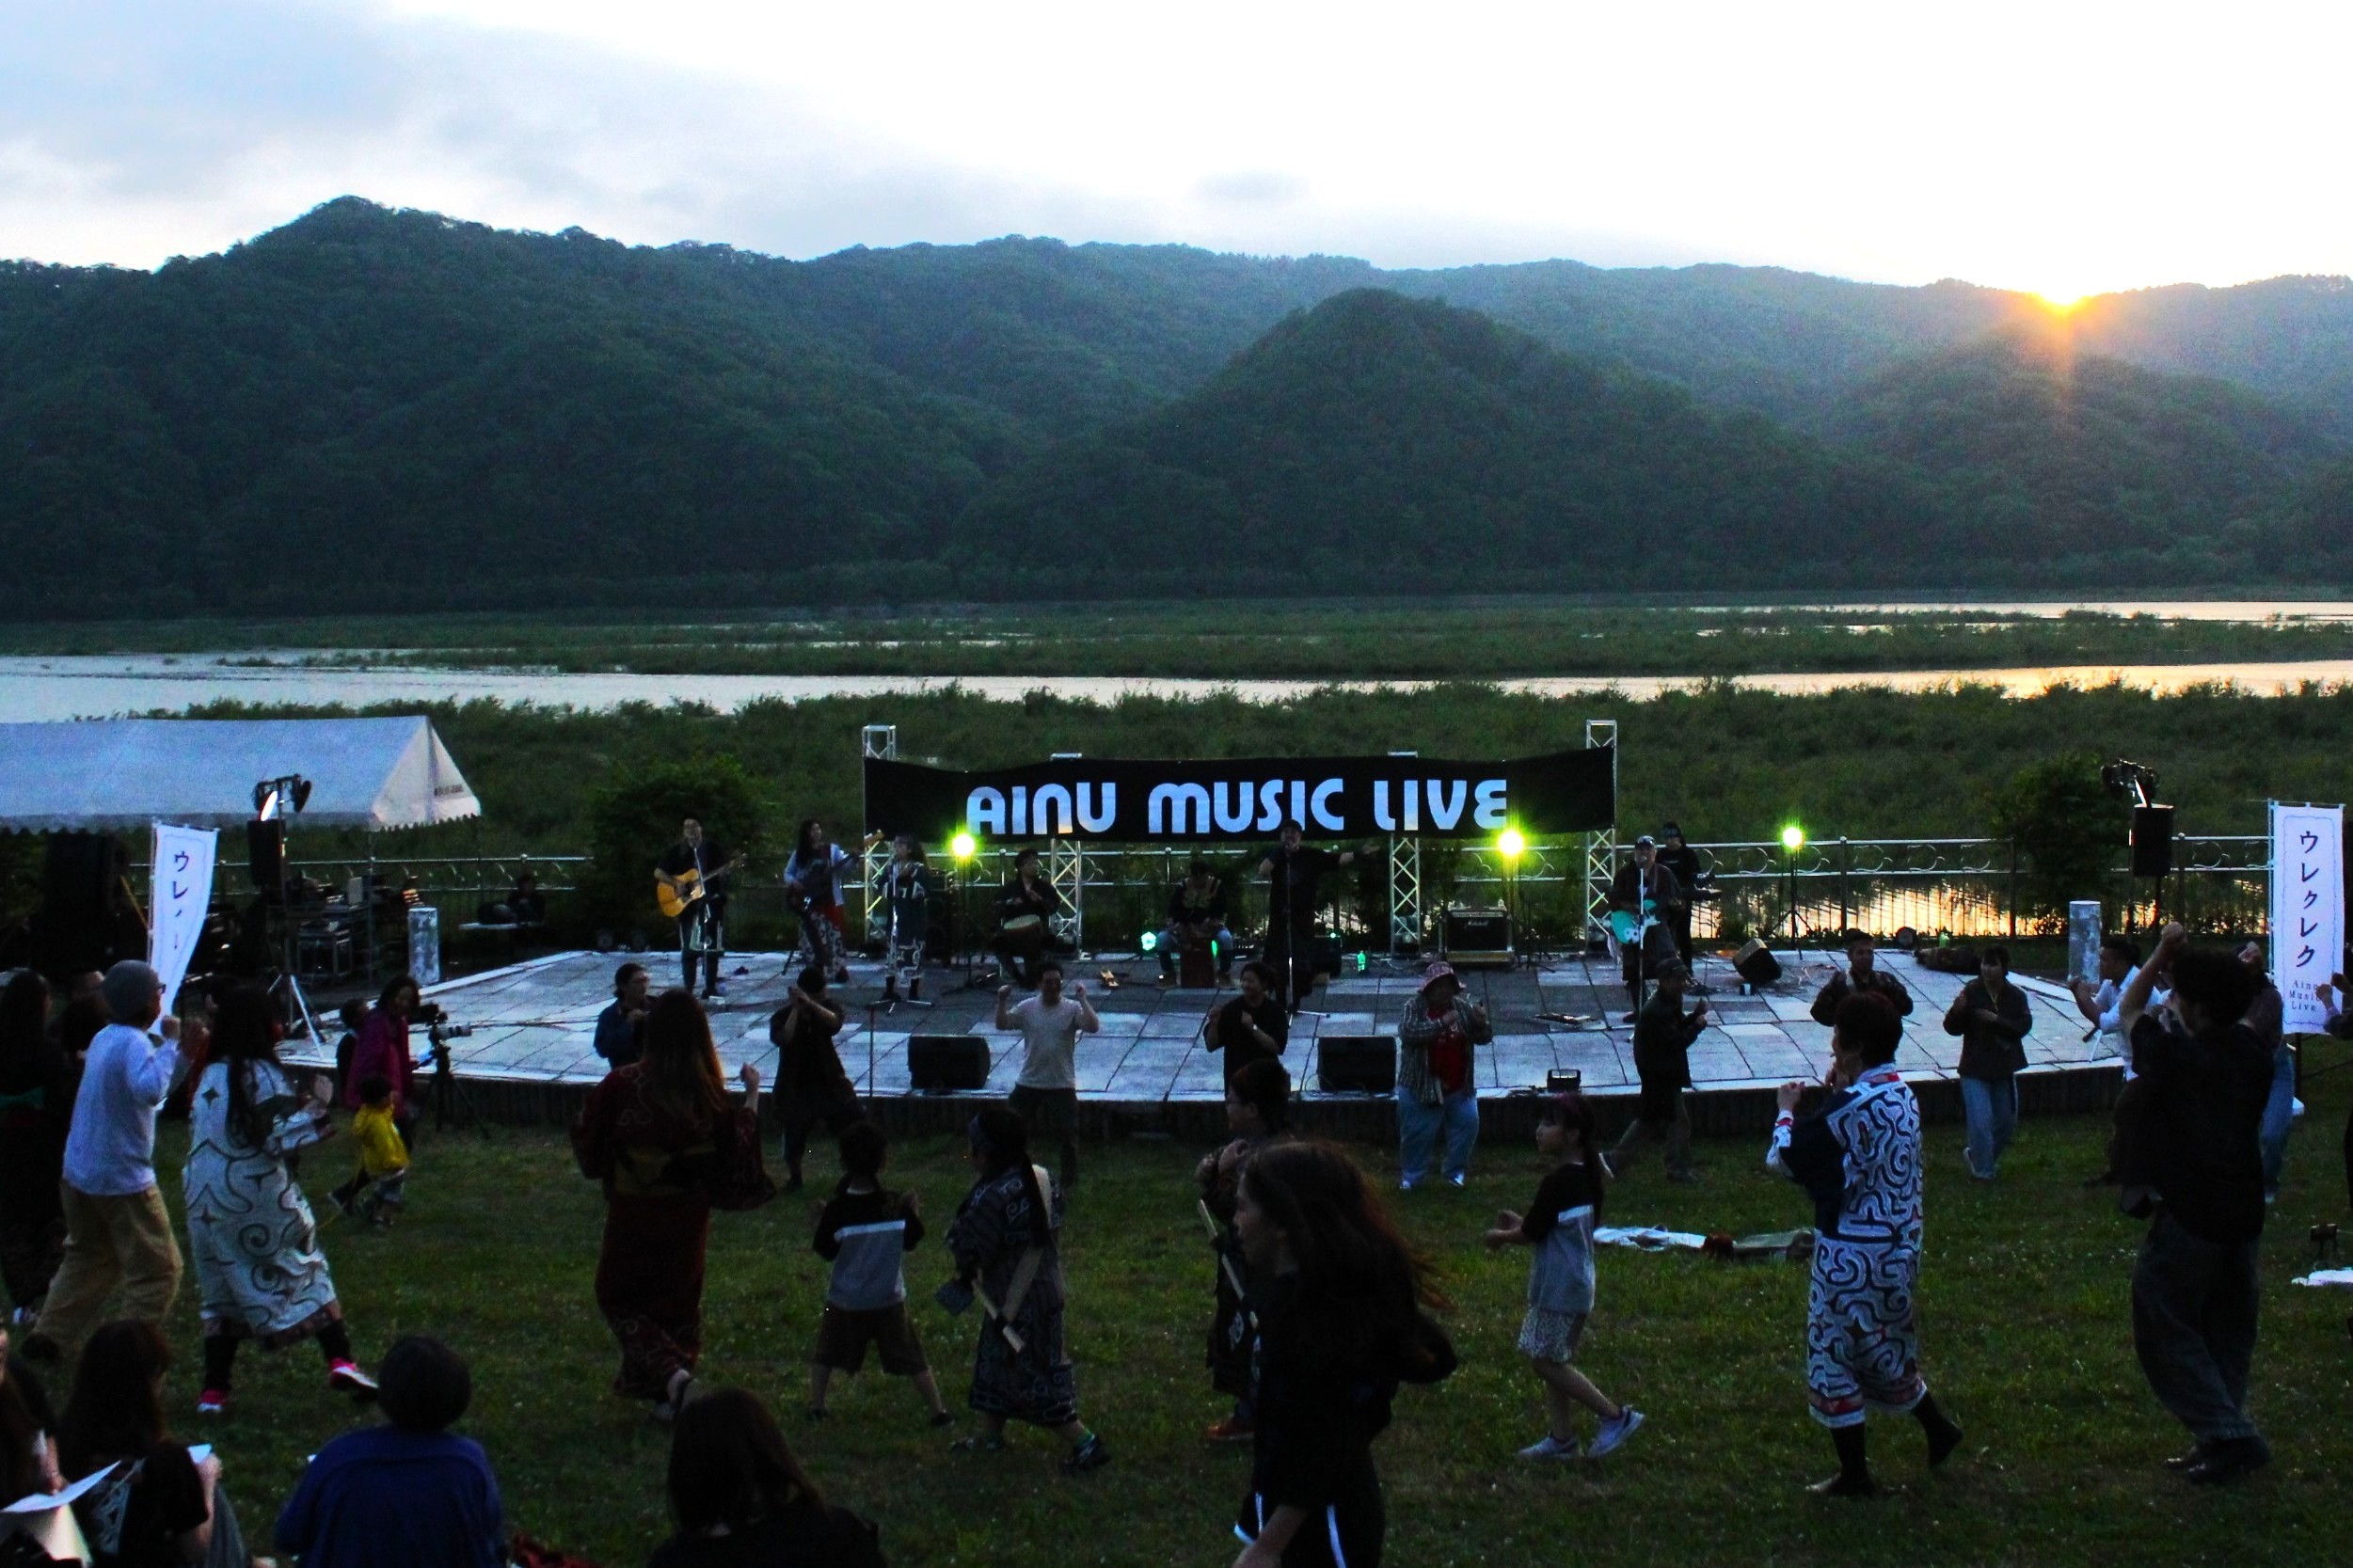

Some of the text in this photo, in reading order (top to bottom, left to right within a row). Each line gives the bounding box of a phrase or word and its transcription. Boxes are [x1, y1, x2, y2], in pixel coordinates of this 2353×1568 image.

[965, 778, 1507, 835] AINU MUSIC LIVE
[2291, 1000, 2316, 1011] Live
